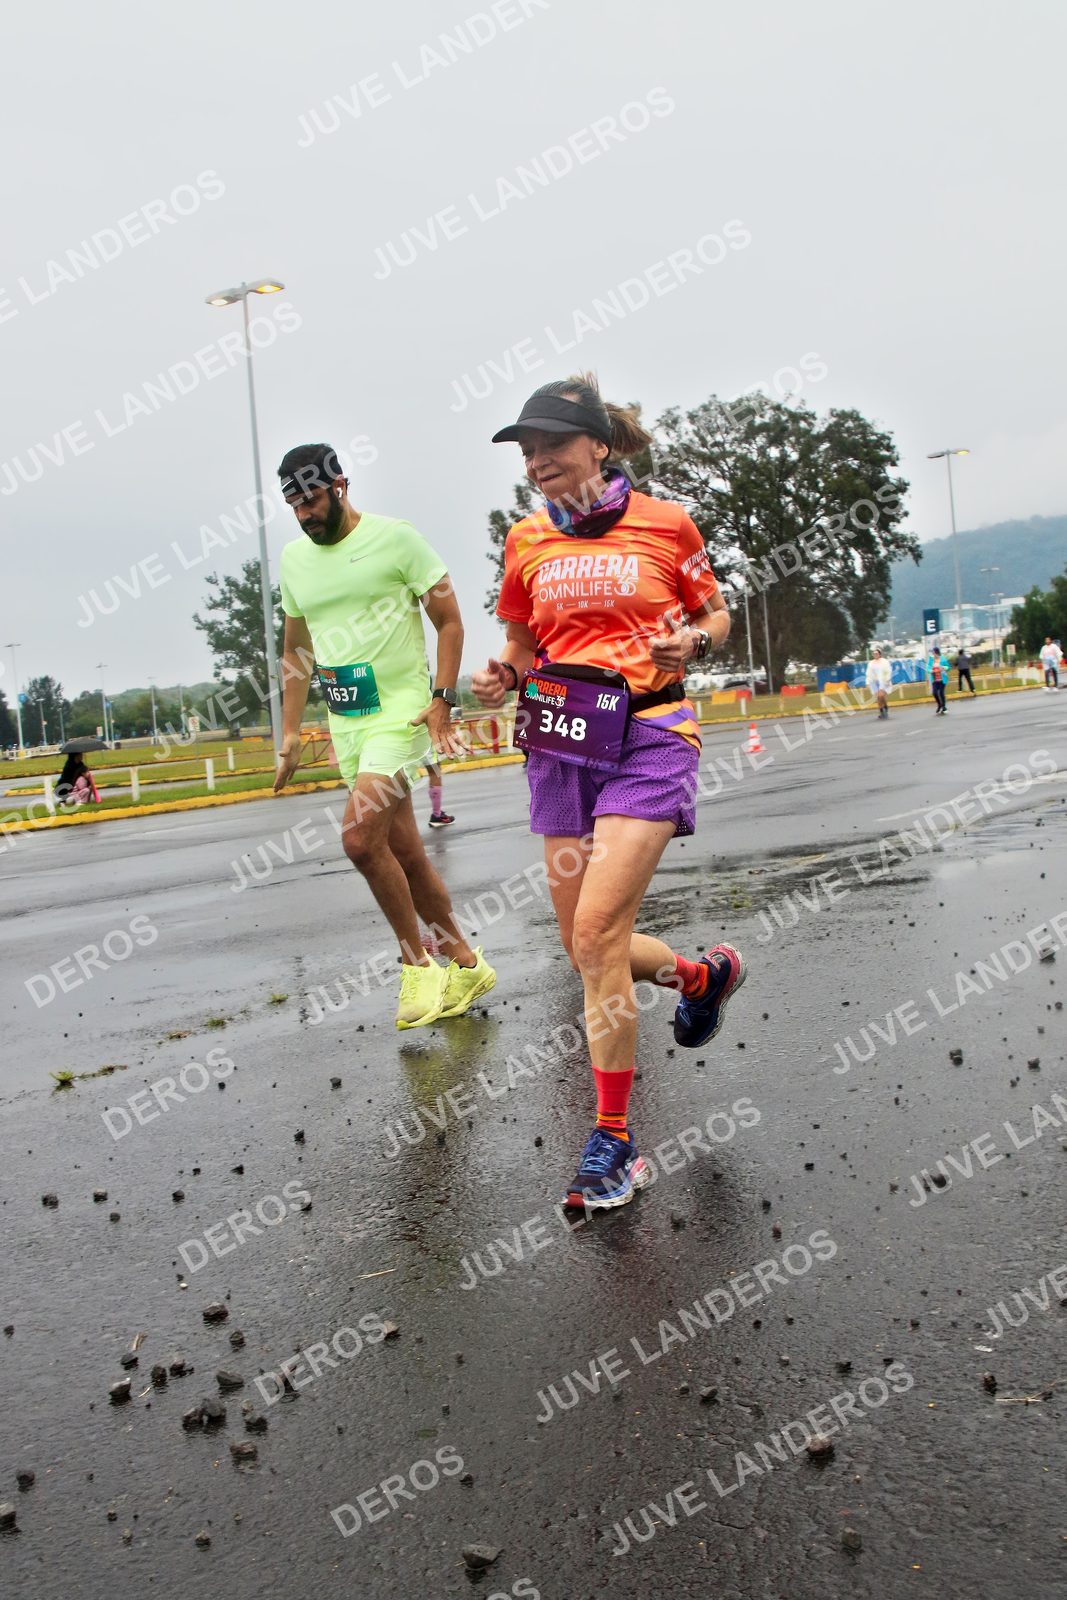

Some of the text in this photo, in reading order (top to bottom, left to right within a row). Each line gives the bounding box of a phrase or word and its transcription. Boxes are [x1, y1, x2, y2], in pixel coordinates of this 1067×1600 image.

[538, 554, 638, 585] CARRERA
[539, 580, 612, 602] OMNILIFE
[926, 619, 936, 632] E
[352, 666, 367, 679] 10K
[327, 686, 358, 702] 1637
[596, 693, 620, 712] 15K
[539, 709, 587, 741] 348
